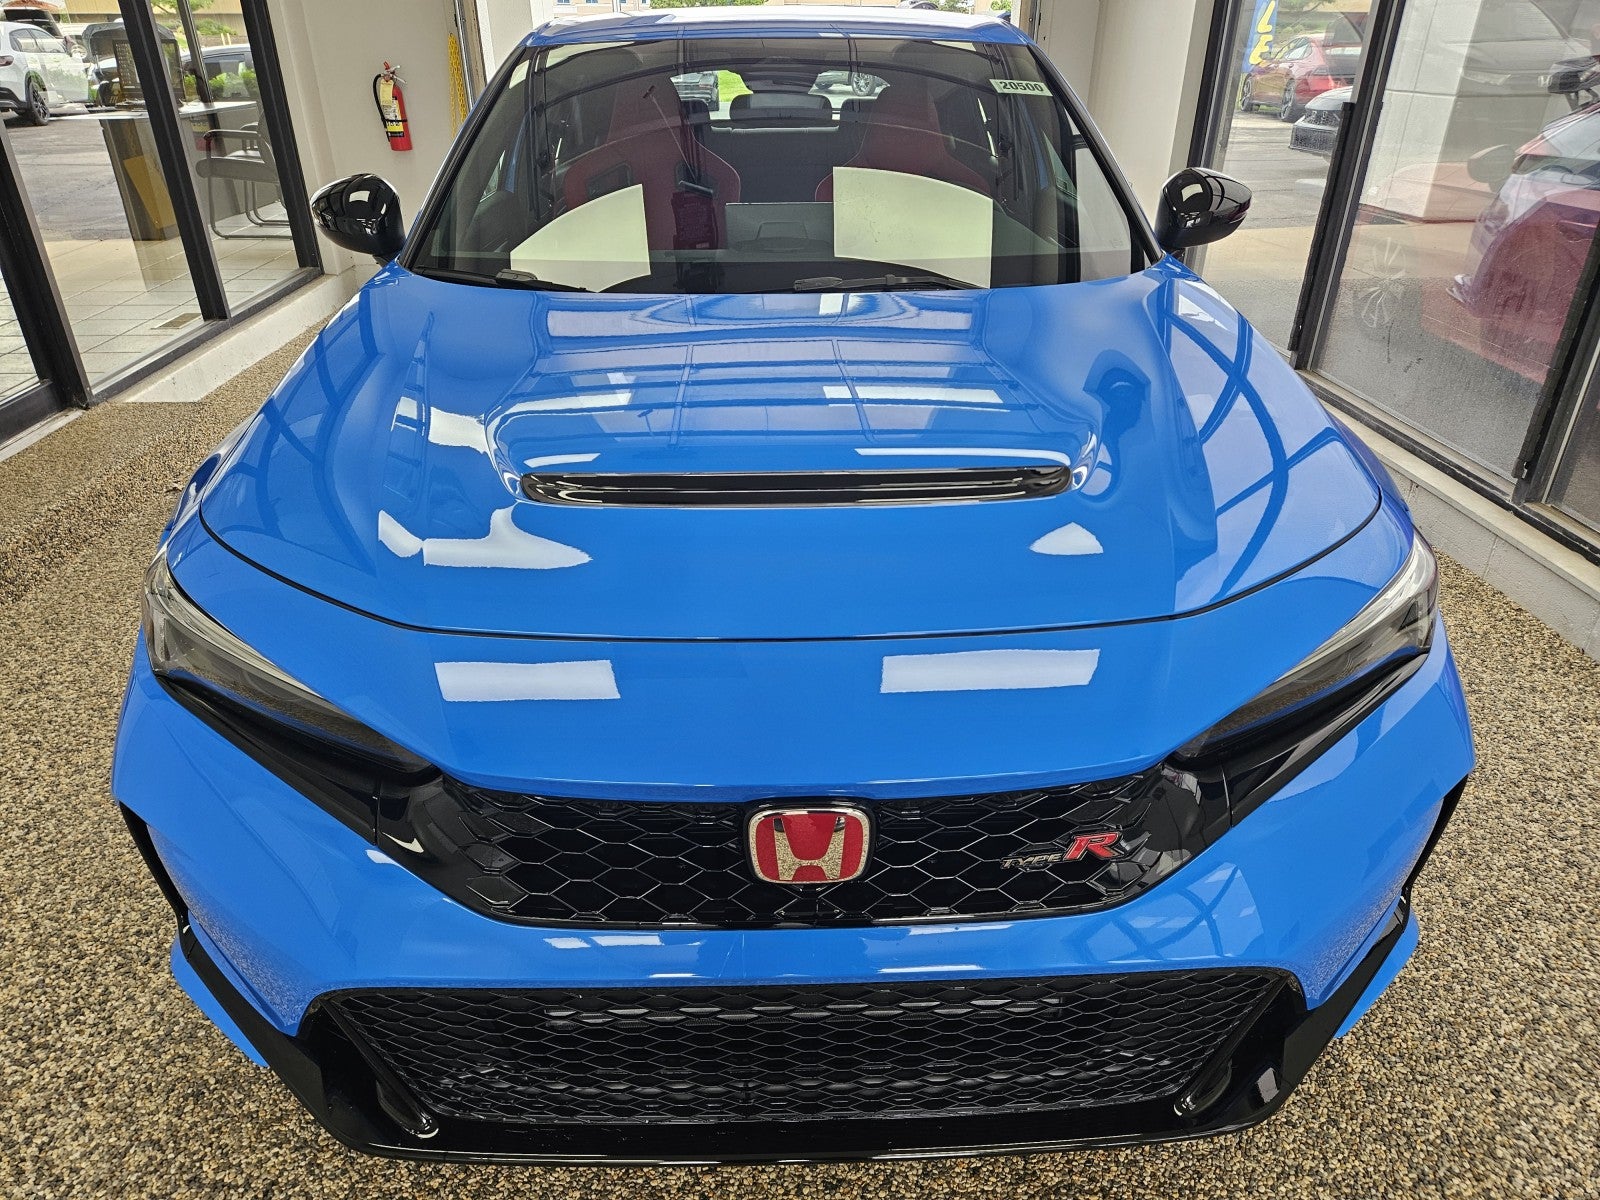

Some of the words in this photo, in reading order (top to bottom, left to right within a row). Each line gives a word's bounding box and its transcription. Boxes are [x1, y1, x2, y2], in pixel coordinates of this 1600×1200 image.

[999, 81, 1044, 92] 20500
[1001, 853, 1062, 869] TYPE
[1063, 832, 1122, 860] R
